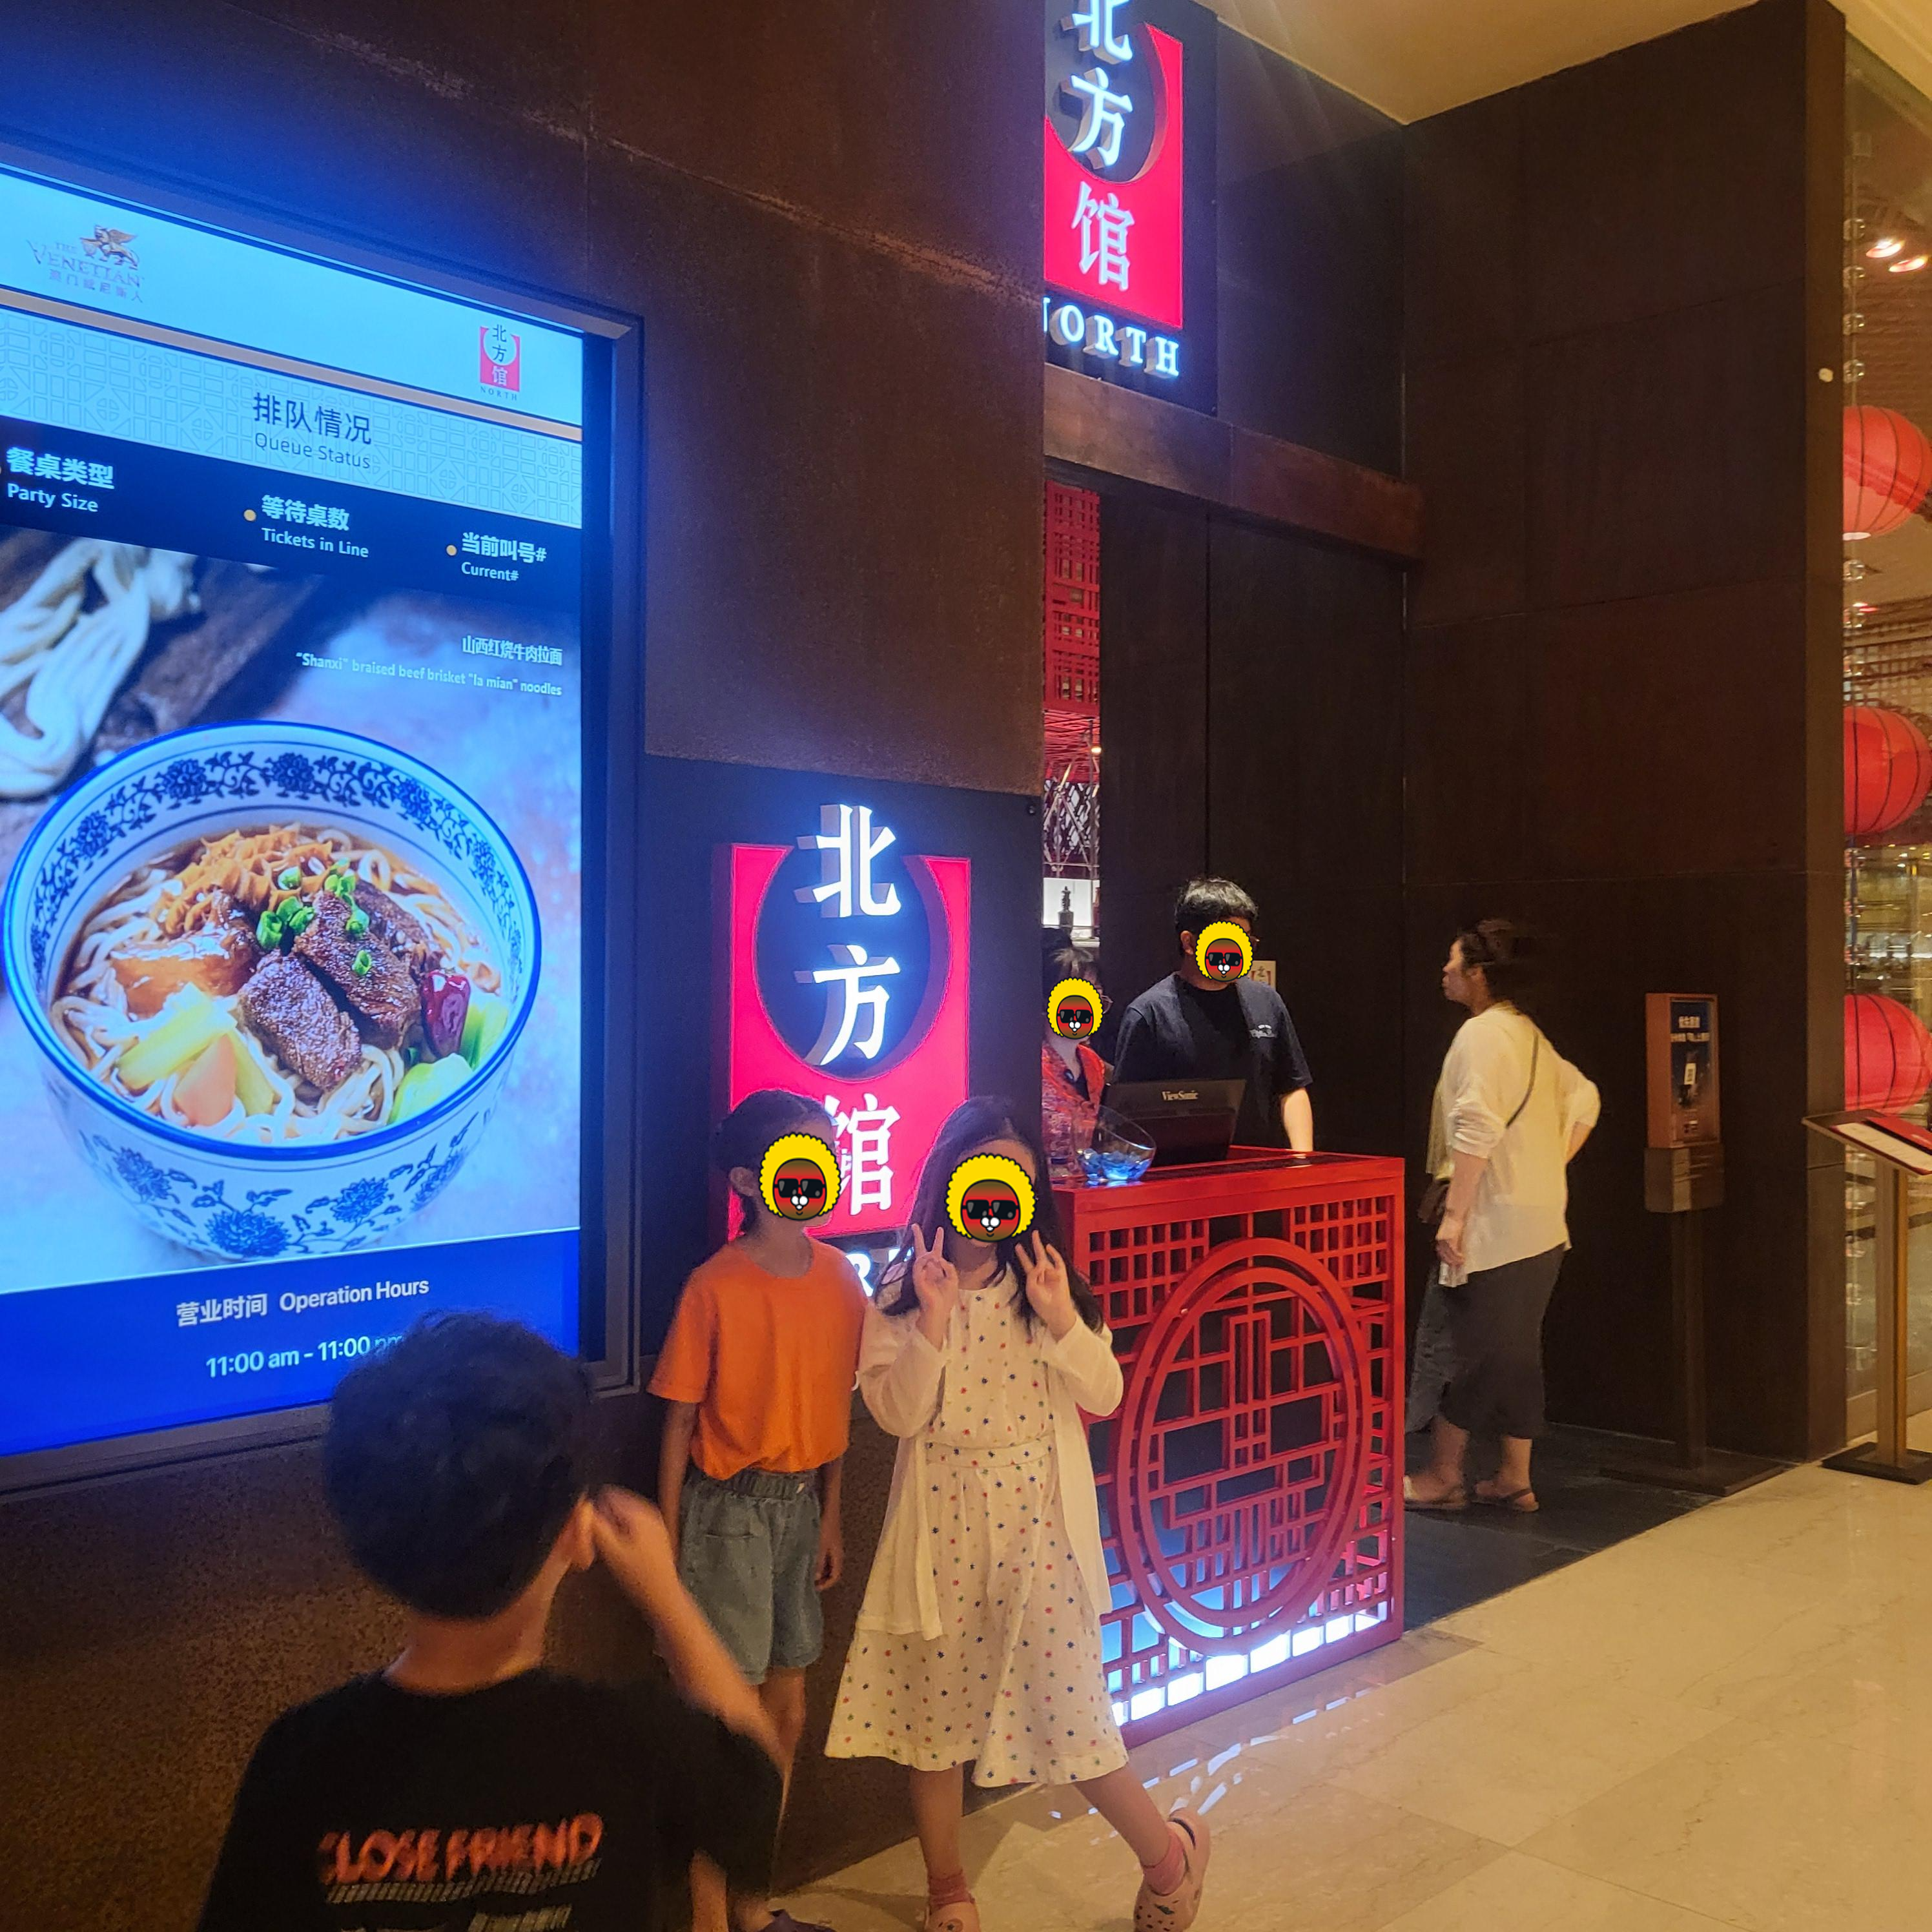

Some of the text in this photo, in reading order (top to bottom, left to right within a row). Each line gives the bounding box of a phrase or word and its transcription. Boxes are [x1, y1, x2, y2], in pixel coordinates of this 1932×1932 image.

[1071, 0, 1135, 291] 北方馆
[26, 240, 141, 288] VENETIAN
[492, 324, 508, 387] 北方馆
[1043, 298, 1180, 378] ORTH
[480, 386, 517, 400] NORTH
[252, 392, 371, 445] 排队情况
[6, 447, 115, 489] 餐桌类型
[255, 433, 371, 469] Queue Status
[8, 483, 99, 512] Party Size
[262, 495, 349, 531] 等待桌数
[262, 528, 369, 559] Tickets in Line
[462, 532, 547, 564] 当前叫号#
[462, 562, 519, 582] Current#
[462, 635, 562, 666] 山西红烧牛肉拉面
[352, 659, 395, 676] braised
[399, 664, 425, 679] beef
[427, 668, 466, 685] brisket
[520, 681, 562, 696] noodles
[812, 804, 901, 1216] 北方馆
[176, 1293, 268, 1328] 营业时间
[279, 1279, 429, 1313] Operation Hours
[205, 1351, 264, 1379] 11:00
[268, 1350, 300, 1370] am
[317, 1335, 371, 1362] 11:00
